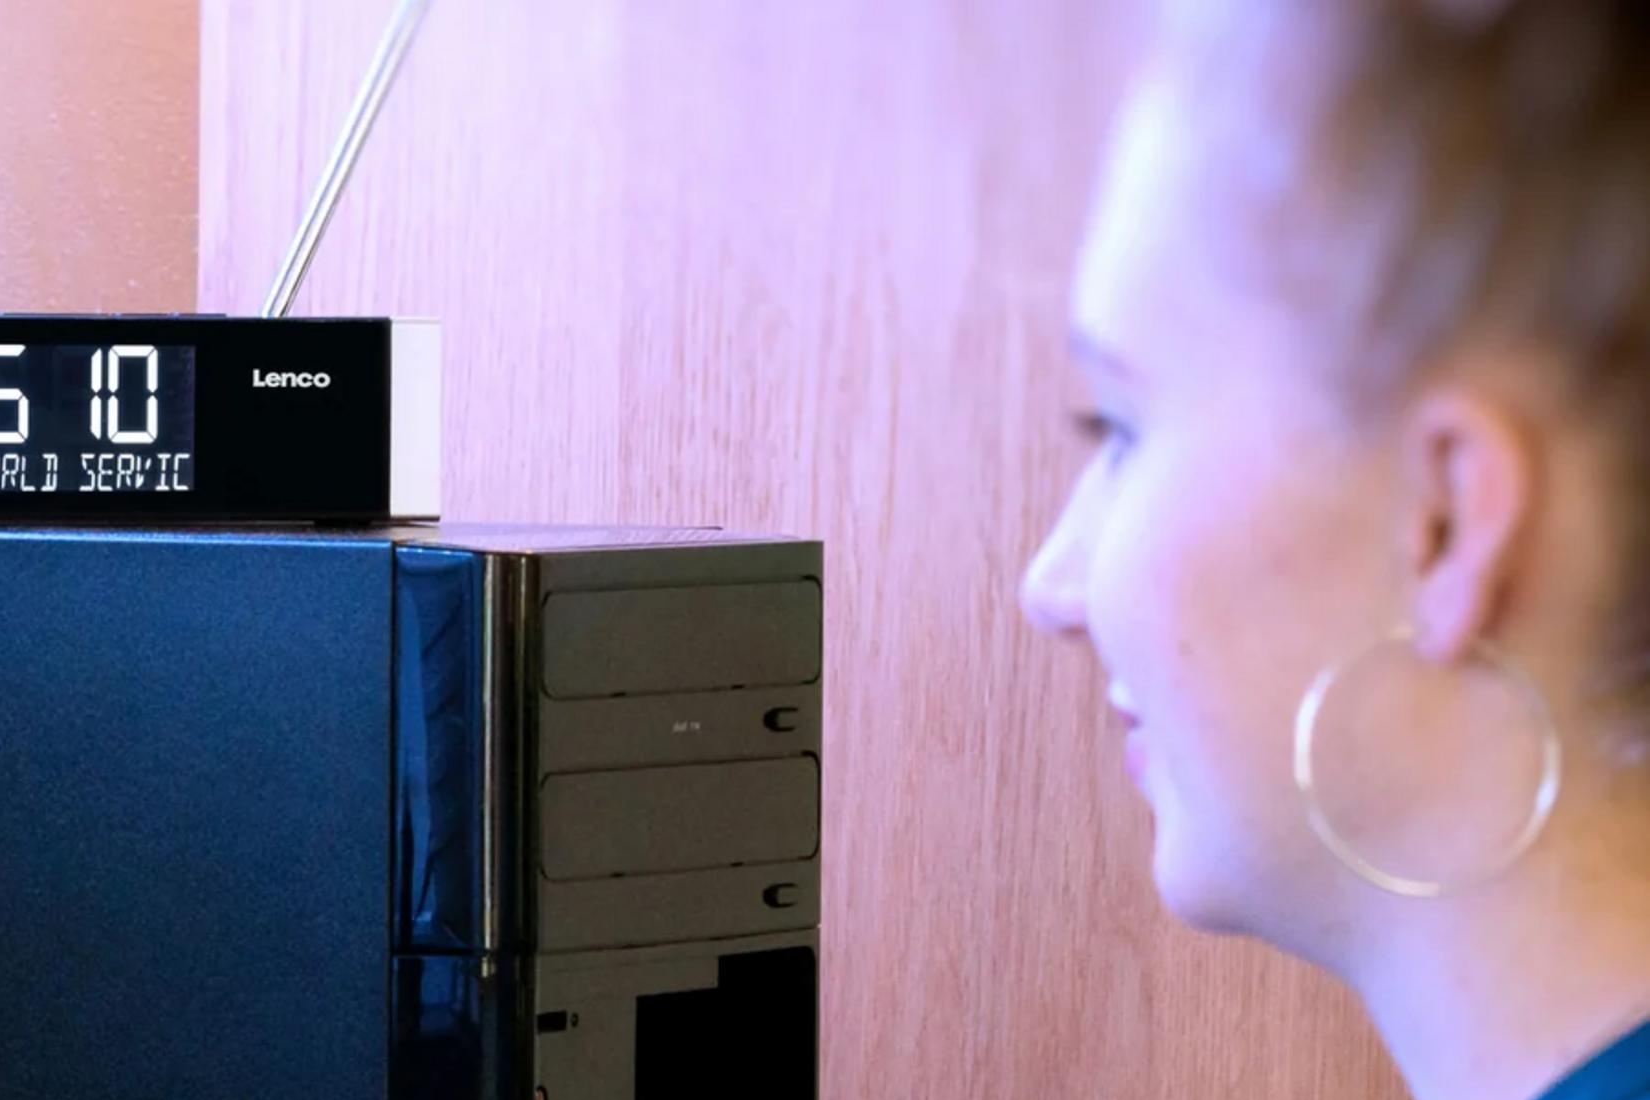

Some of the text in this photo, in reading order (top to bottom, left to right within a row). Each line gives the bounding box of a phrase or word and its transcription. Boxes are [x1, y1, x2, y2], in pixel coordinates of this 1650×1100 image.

[90, 344, 159, 444] 10
[252, 368, 331, 388] Lenco
[78, 453, 191, 493] SERVIC
